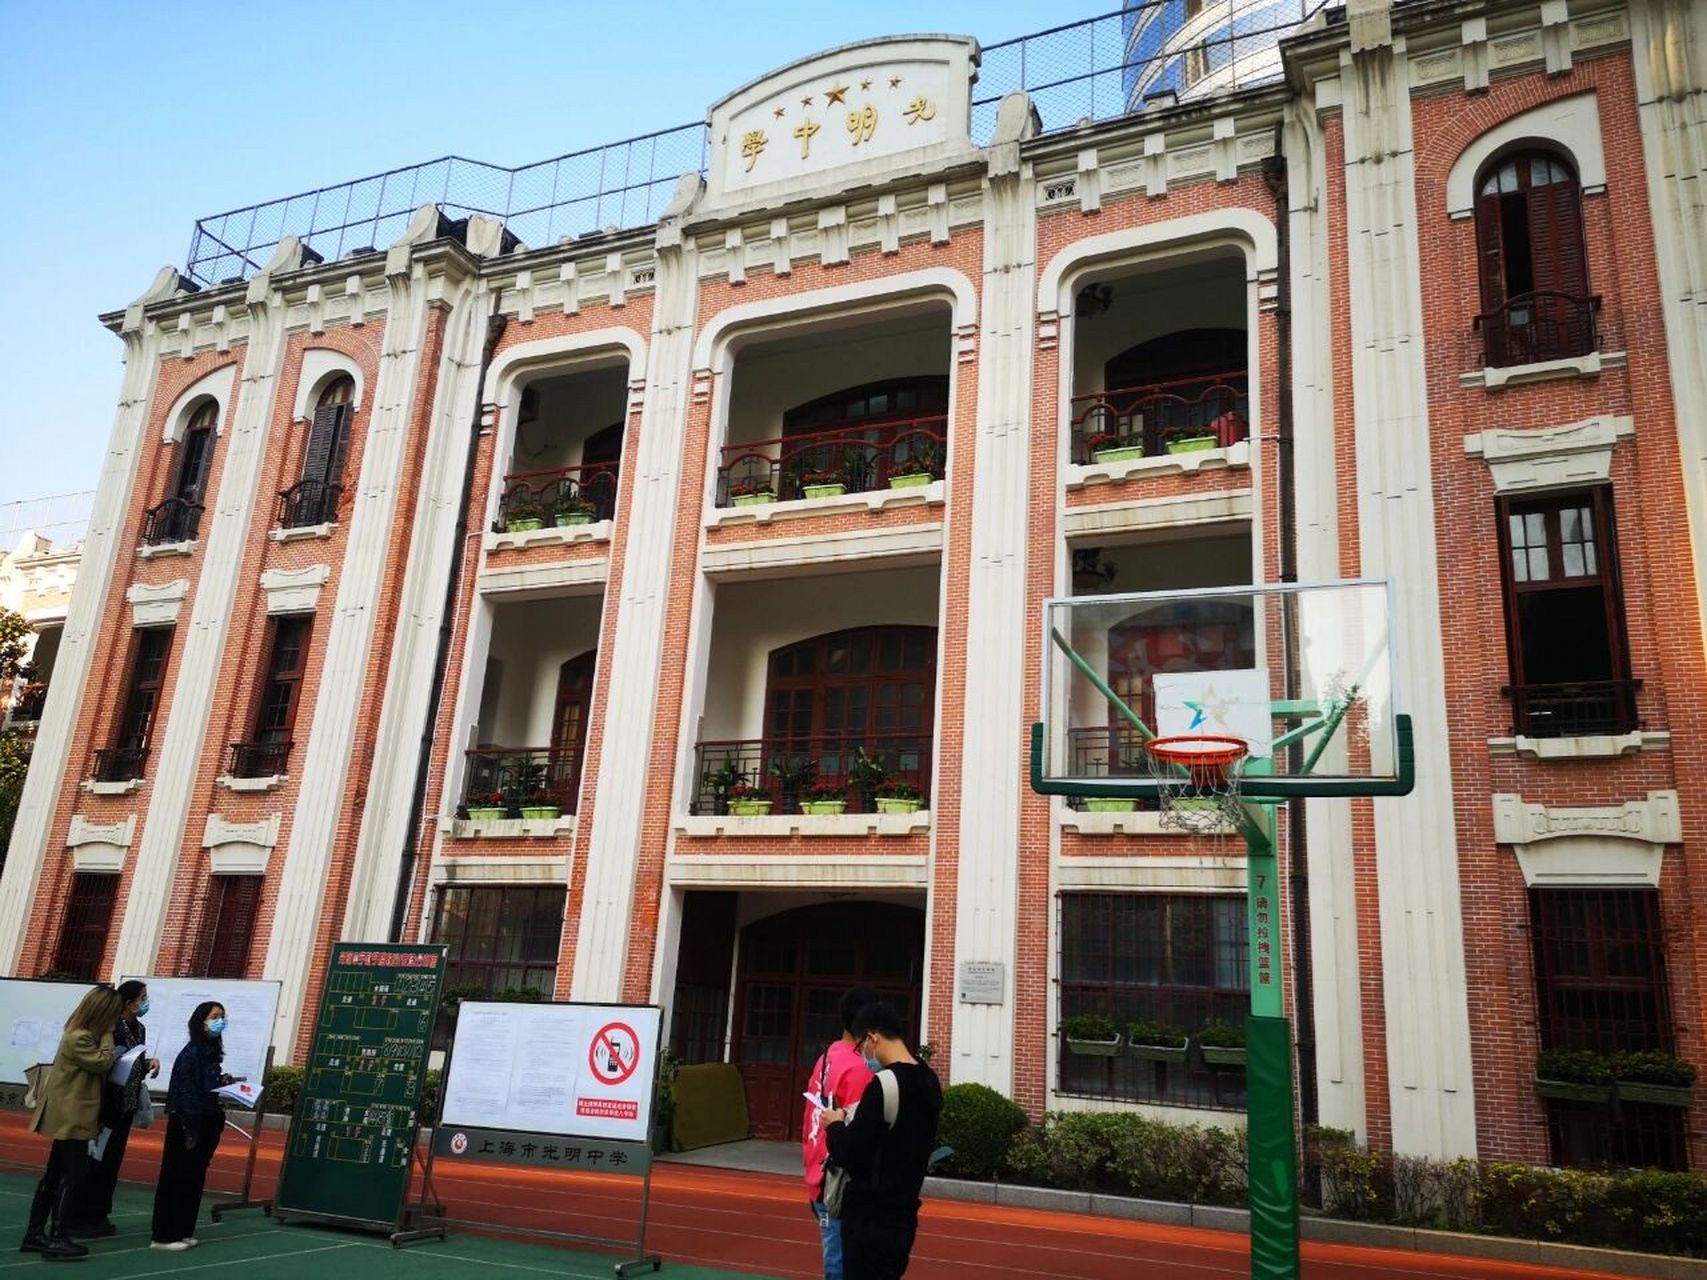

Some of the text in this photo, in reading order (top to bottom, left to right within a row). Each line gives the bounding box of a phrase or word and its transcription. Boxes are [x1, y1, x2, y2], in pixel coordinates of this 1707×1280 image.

[1256, 875, 1266, 888] 7
[477, 1139, 628, 1167] 上海市光明中学
